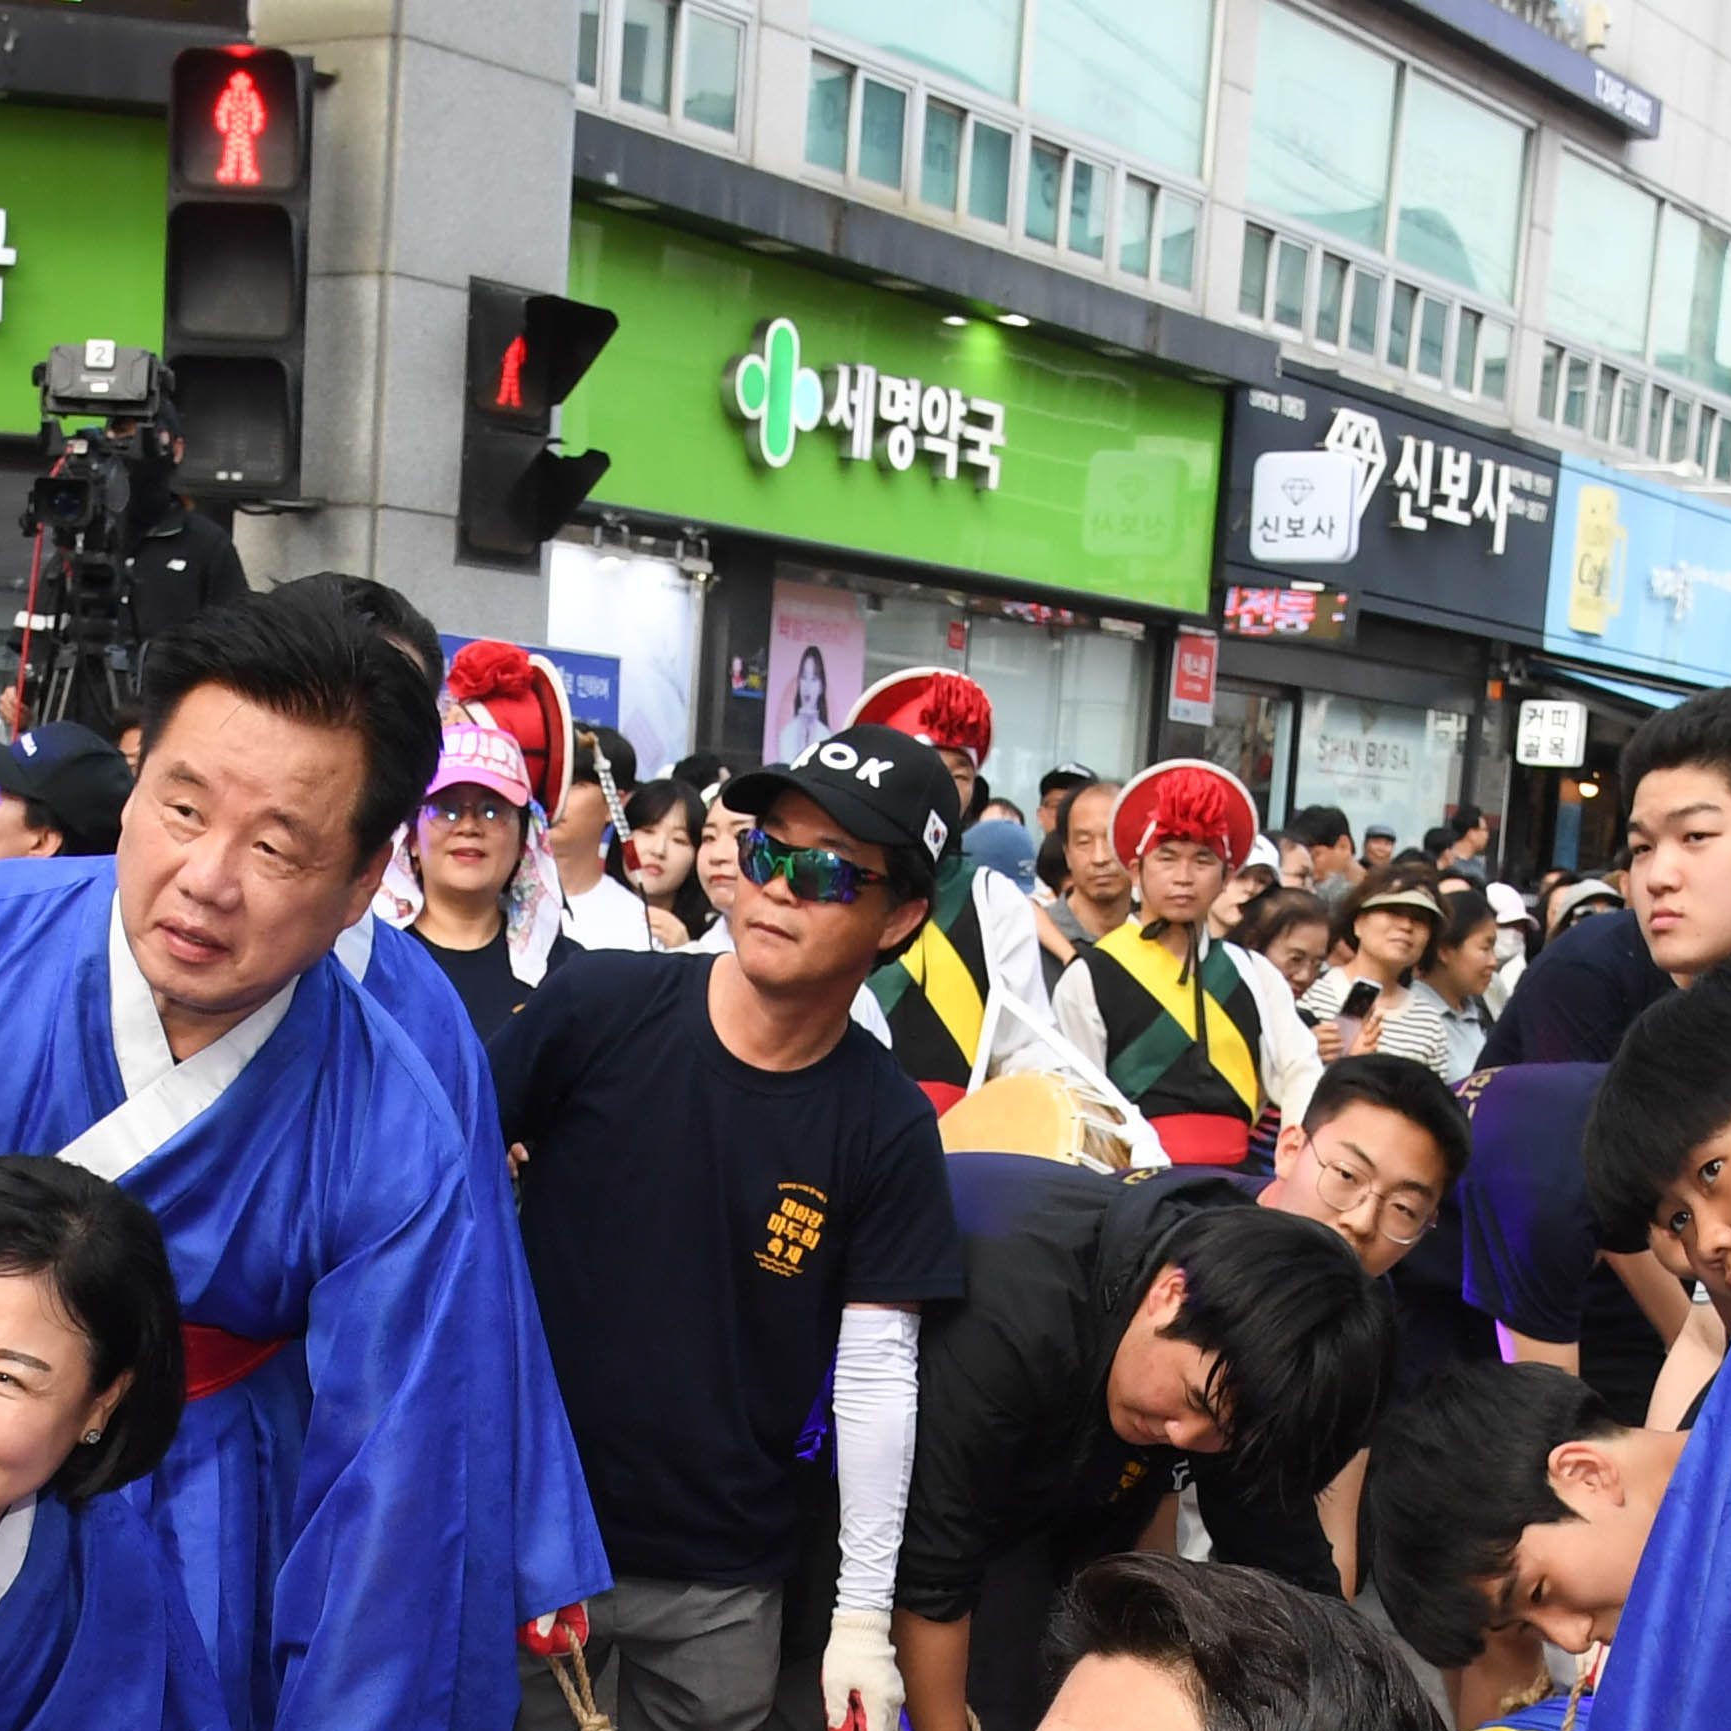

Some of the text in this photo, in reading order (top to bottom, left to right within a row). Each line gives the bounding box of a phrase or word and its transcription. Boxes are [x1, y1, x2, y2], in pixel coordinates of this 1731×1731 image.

[94, 346, 106, 362] 2
[826, 363, 1006, 491] 세명약국
[1391, 434, 1515, 556] 신보사
[1257, 515, 1337, 543] 신보사
[781, 1197, 826, 1229] 태화강
[767, 1212, 821, 1251] 마두희
